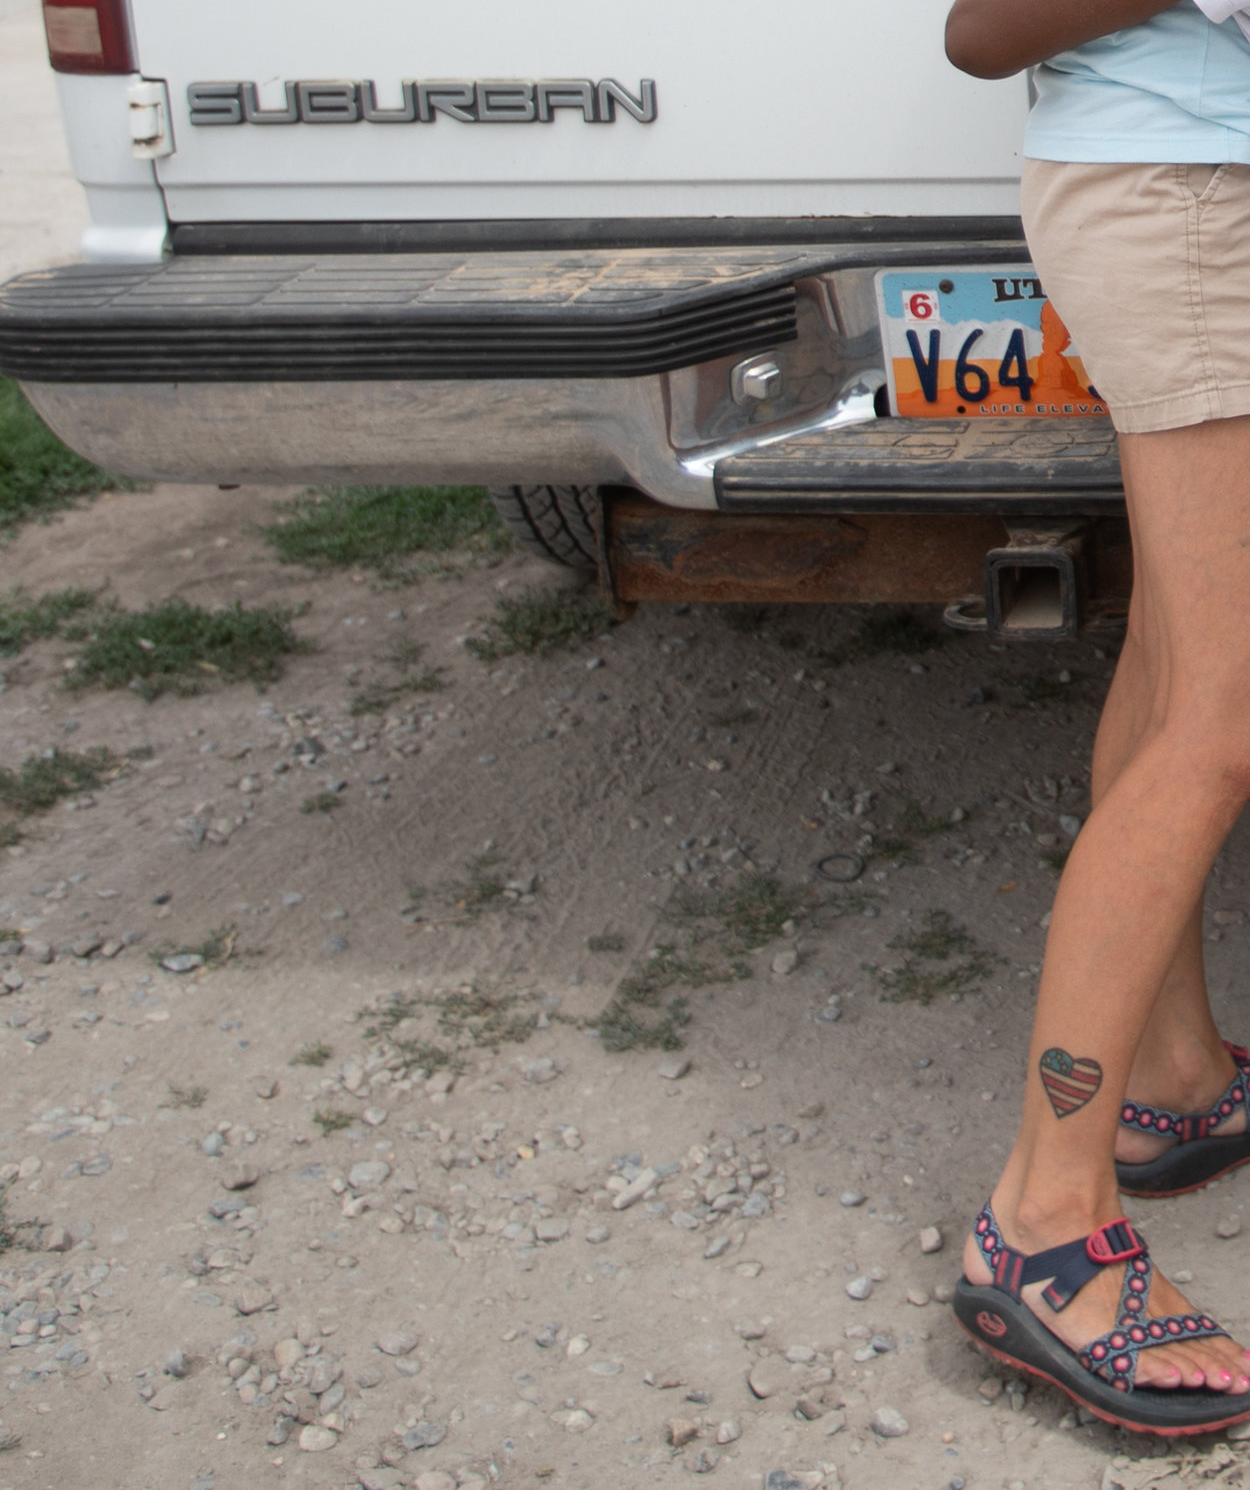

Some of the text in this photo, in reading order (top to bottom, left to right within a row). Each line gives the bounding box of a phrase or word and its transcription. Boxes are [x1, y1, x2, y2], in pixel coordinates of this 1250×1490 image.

[187, 77, 658, 125] SUBURBAN
[909, 293, 933, 320] 6
[905, 328, 1035, 403] V64
[980, 404, 1105, 414] LIFE ELEVA
